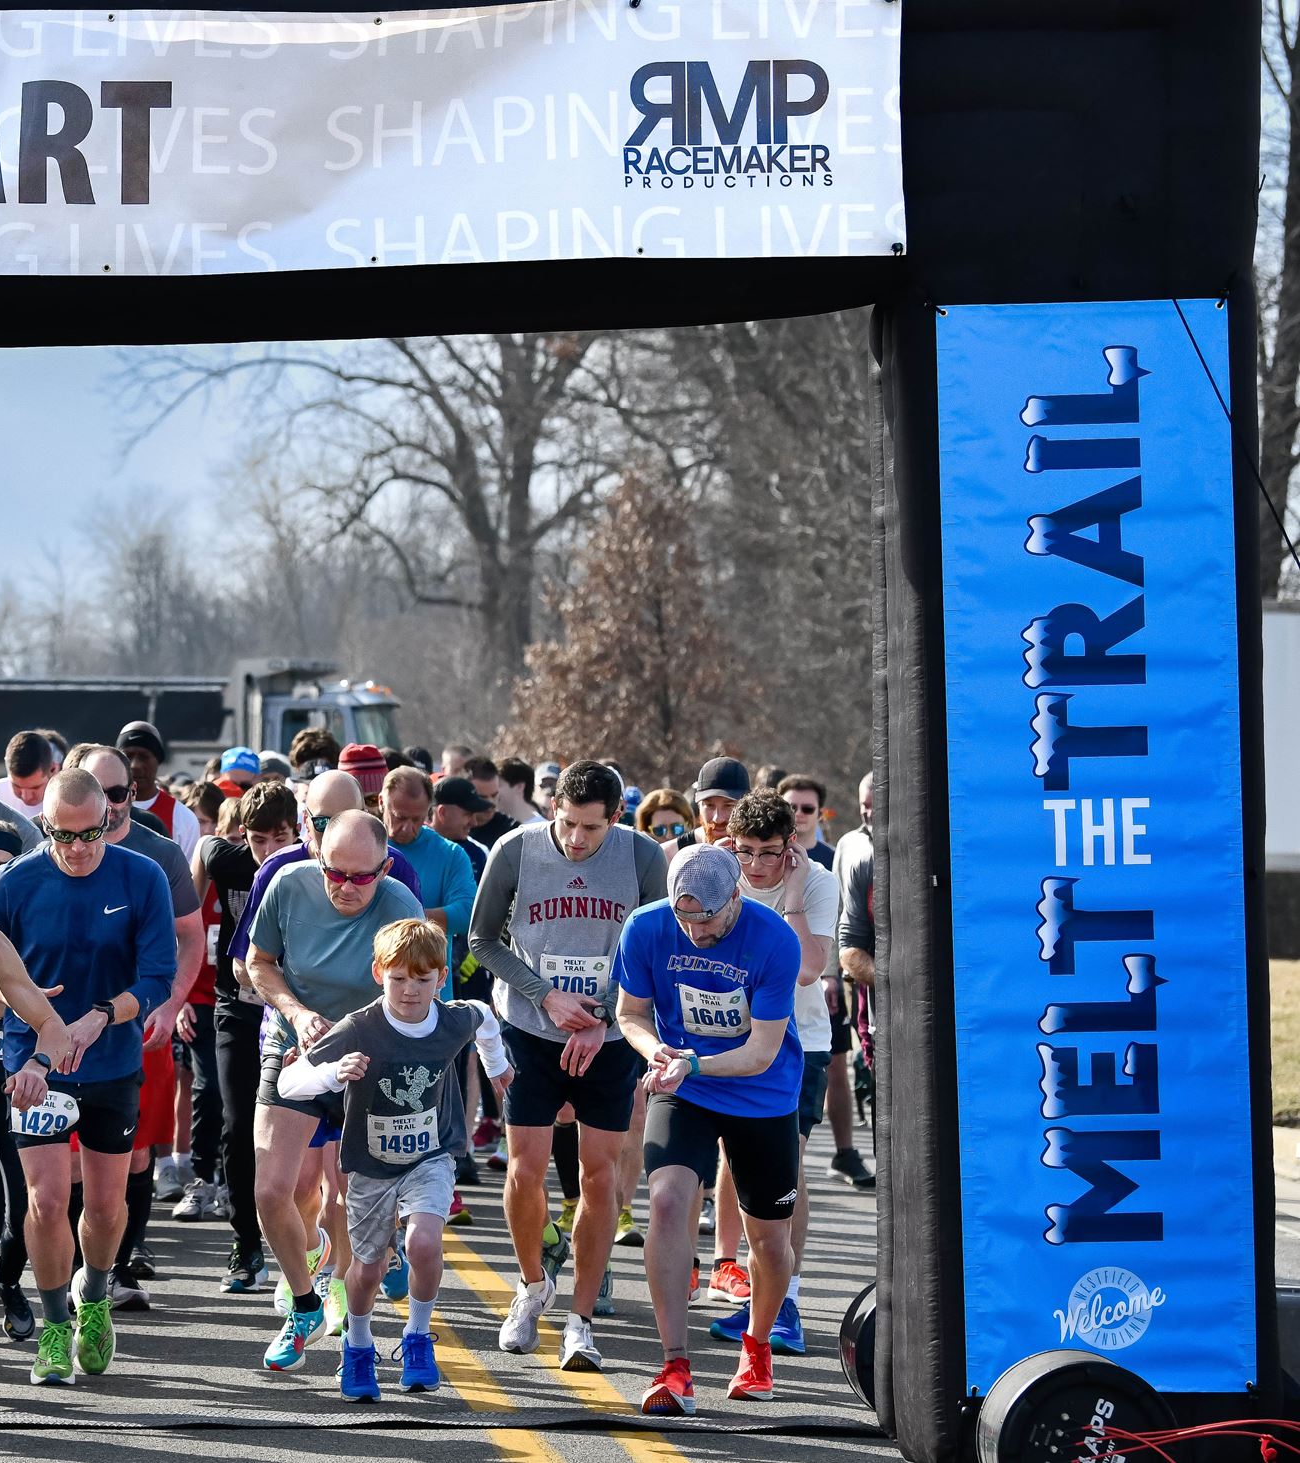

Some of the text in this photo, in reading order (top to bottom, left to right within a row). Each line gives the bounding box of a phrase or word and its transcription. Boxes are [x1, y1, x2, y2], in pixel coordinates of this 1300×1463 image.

[623, 145, 831, 175] RACEMAKER
[624, 174, 834, 189] PRODUCTIONS
[1019, 344, 1153, 791] TRAIL
[1043, 797, 1152, 867] THE
[529, 896, 626, 925] RUNNING
[549, 975, 598, 997] 1705
[699, 992, 717, 1000] MELT
[688, 1006, 742, 1028] 1648
[1035, 876, 1170, 1246] MELT
[19, 1110, 69, 1135] 1429
[377, 1131, 430, 1154] 1499
[1073, 1269, 1140, 1301] WESTFIELD
[1053, 1286, 1167, 1344] Welcome
[1094, 1315, 1147, 1346] INDIANA
